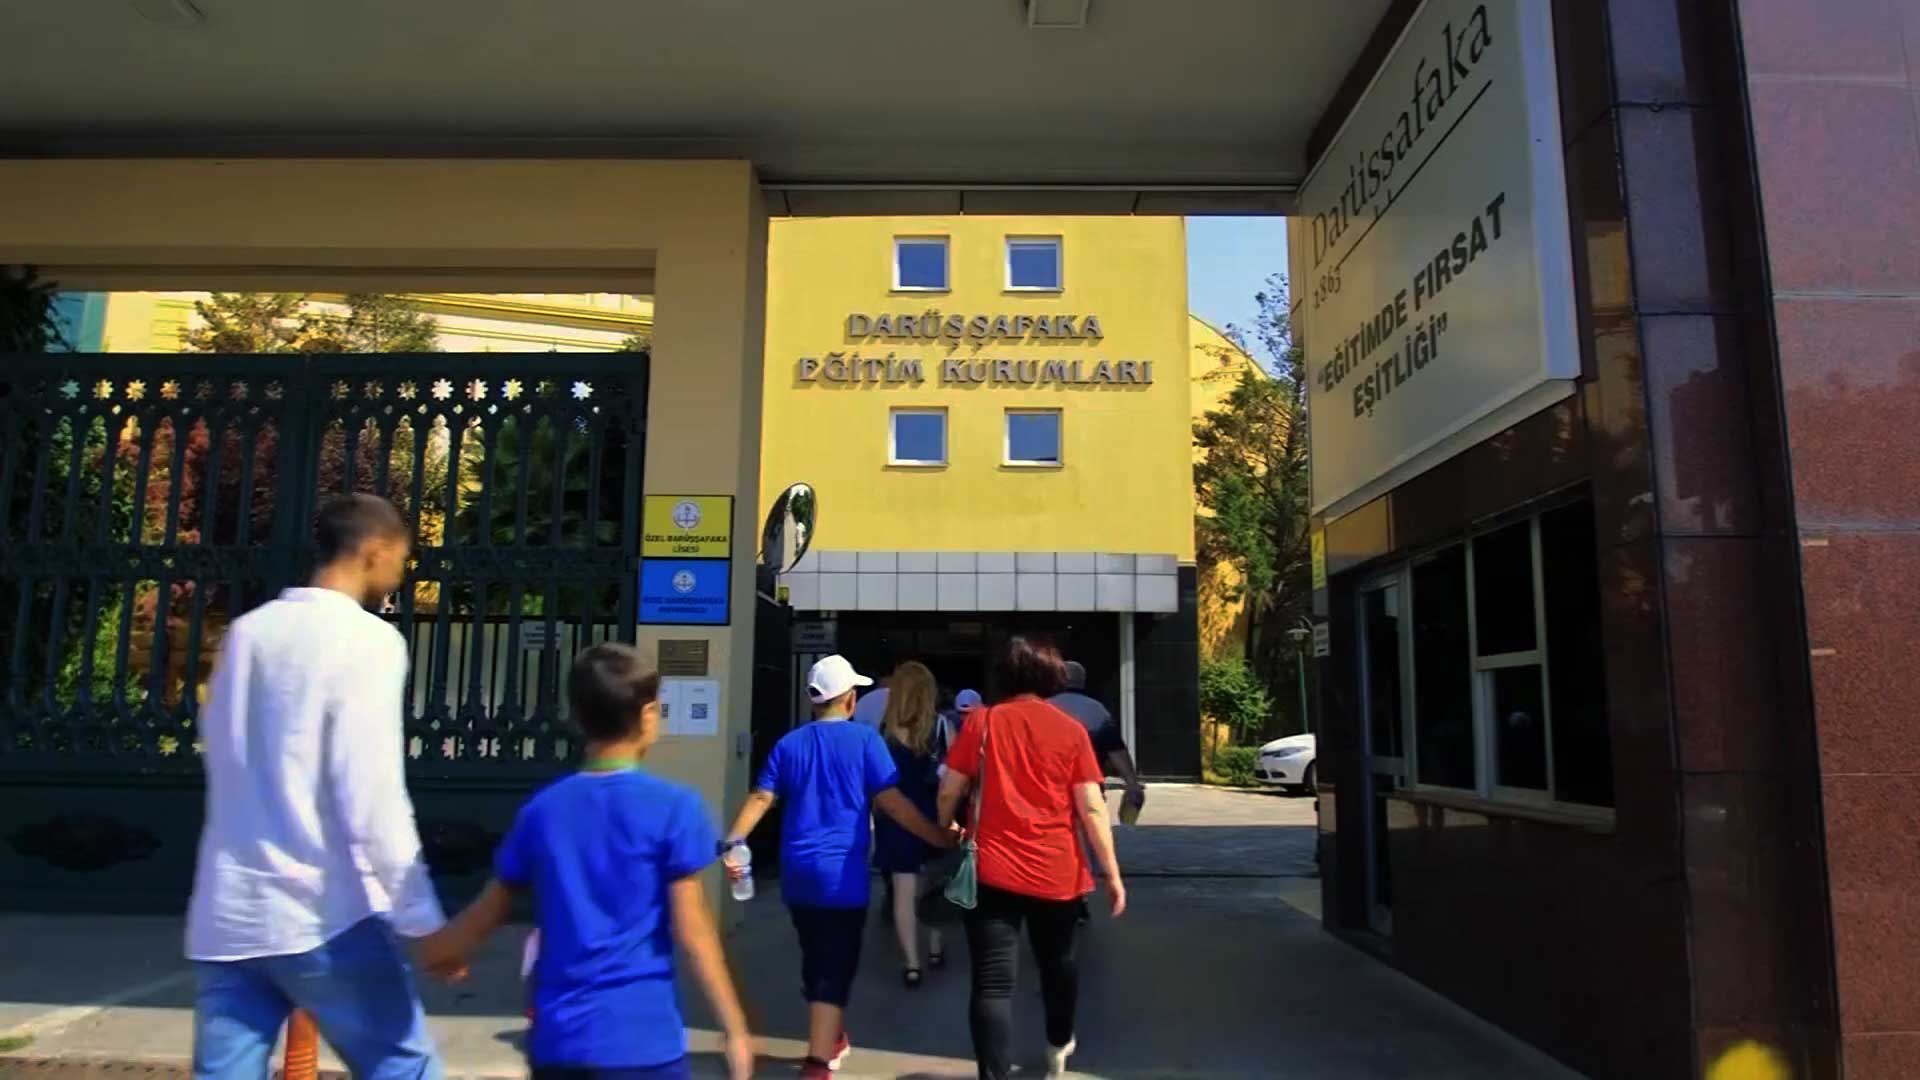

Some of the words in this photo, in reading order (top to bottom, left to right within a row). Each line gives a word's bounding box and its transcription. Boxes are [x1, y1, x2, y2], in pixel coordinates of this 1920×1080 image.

[1413, 192, 1505, 312] FIRSAT
[1314, 266, 1341, 309] 1863
[846, 309, 1104, 353] DARÜŞŞAFAKA
[795, 352, 925, 387] EĞİTİM
[940, 358, 1153, 390] KURUMLARI
